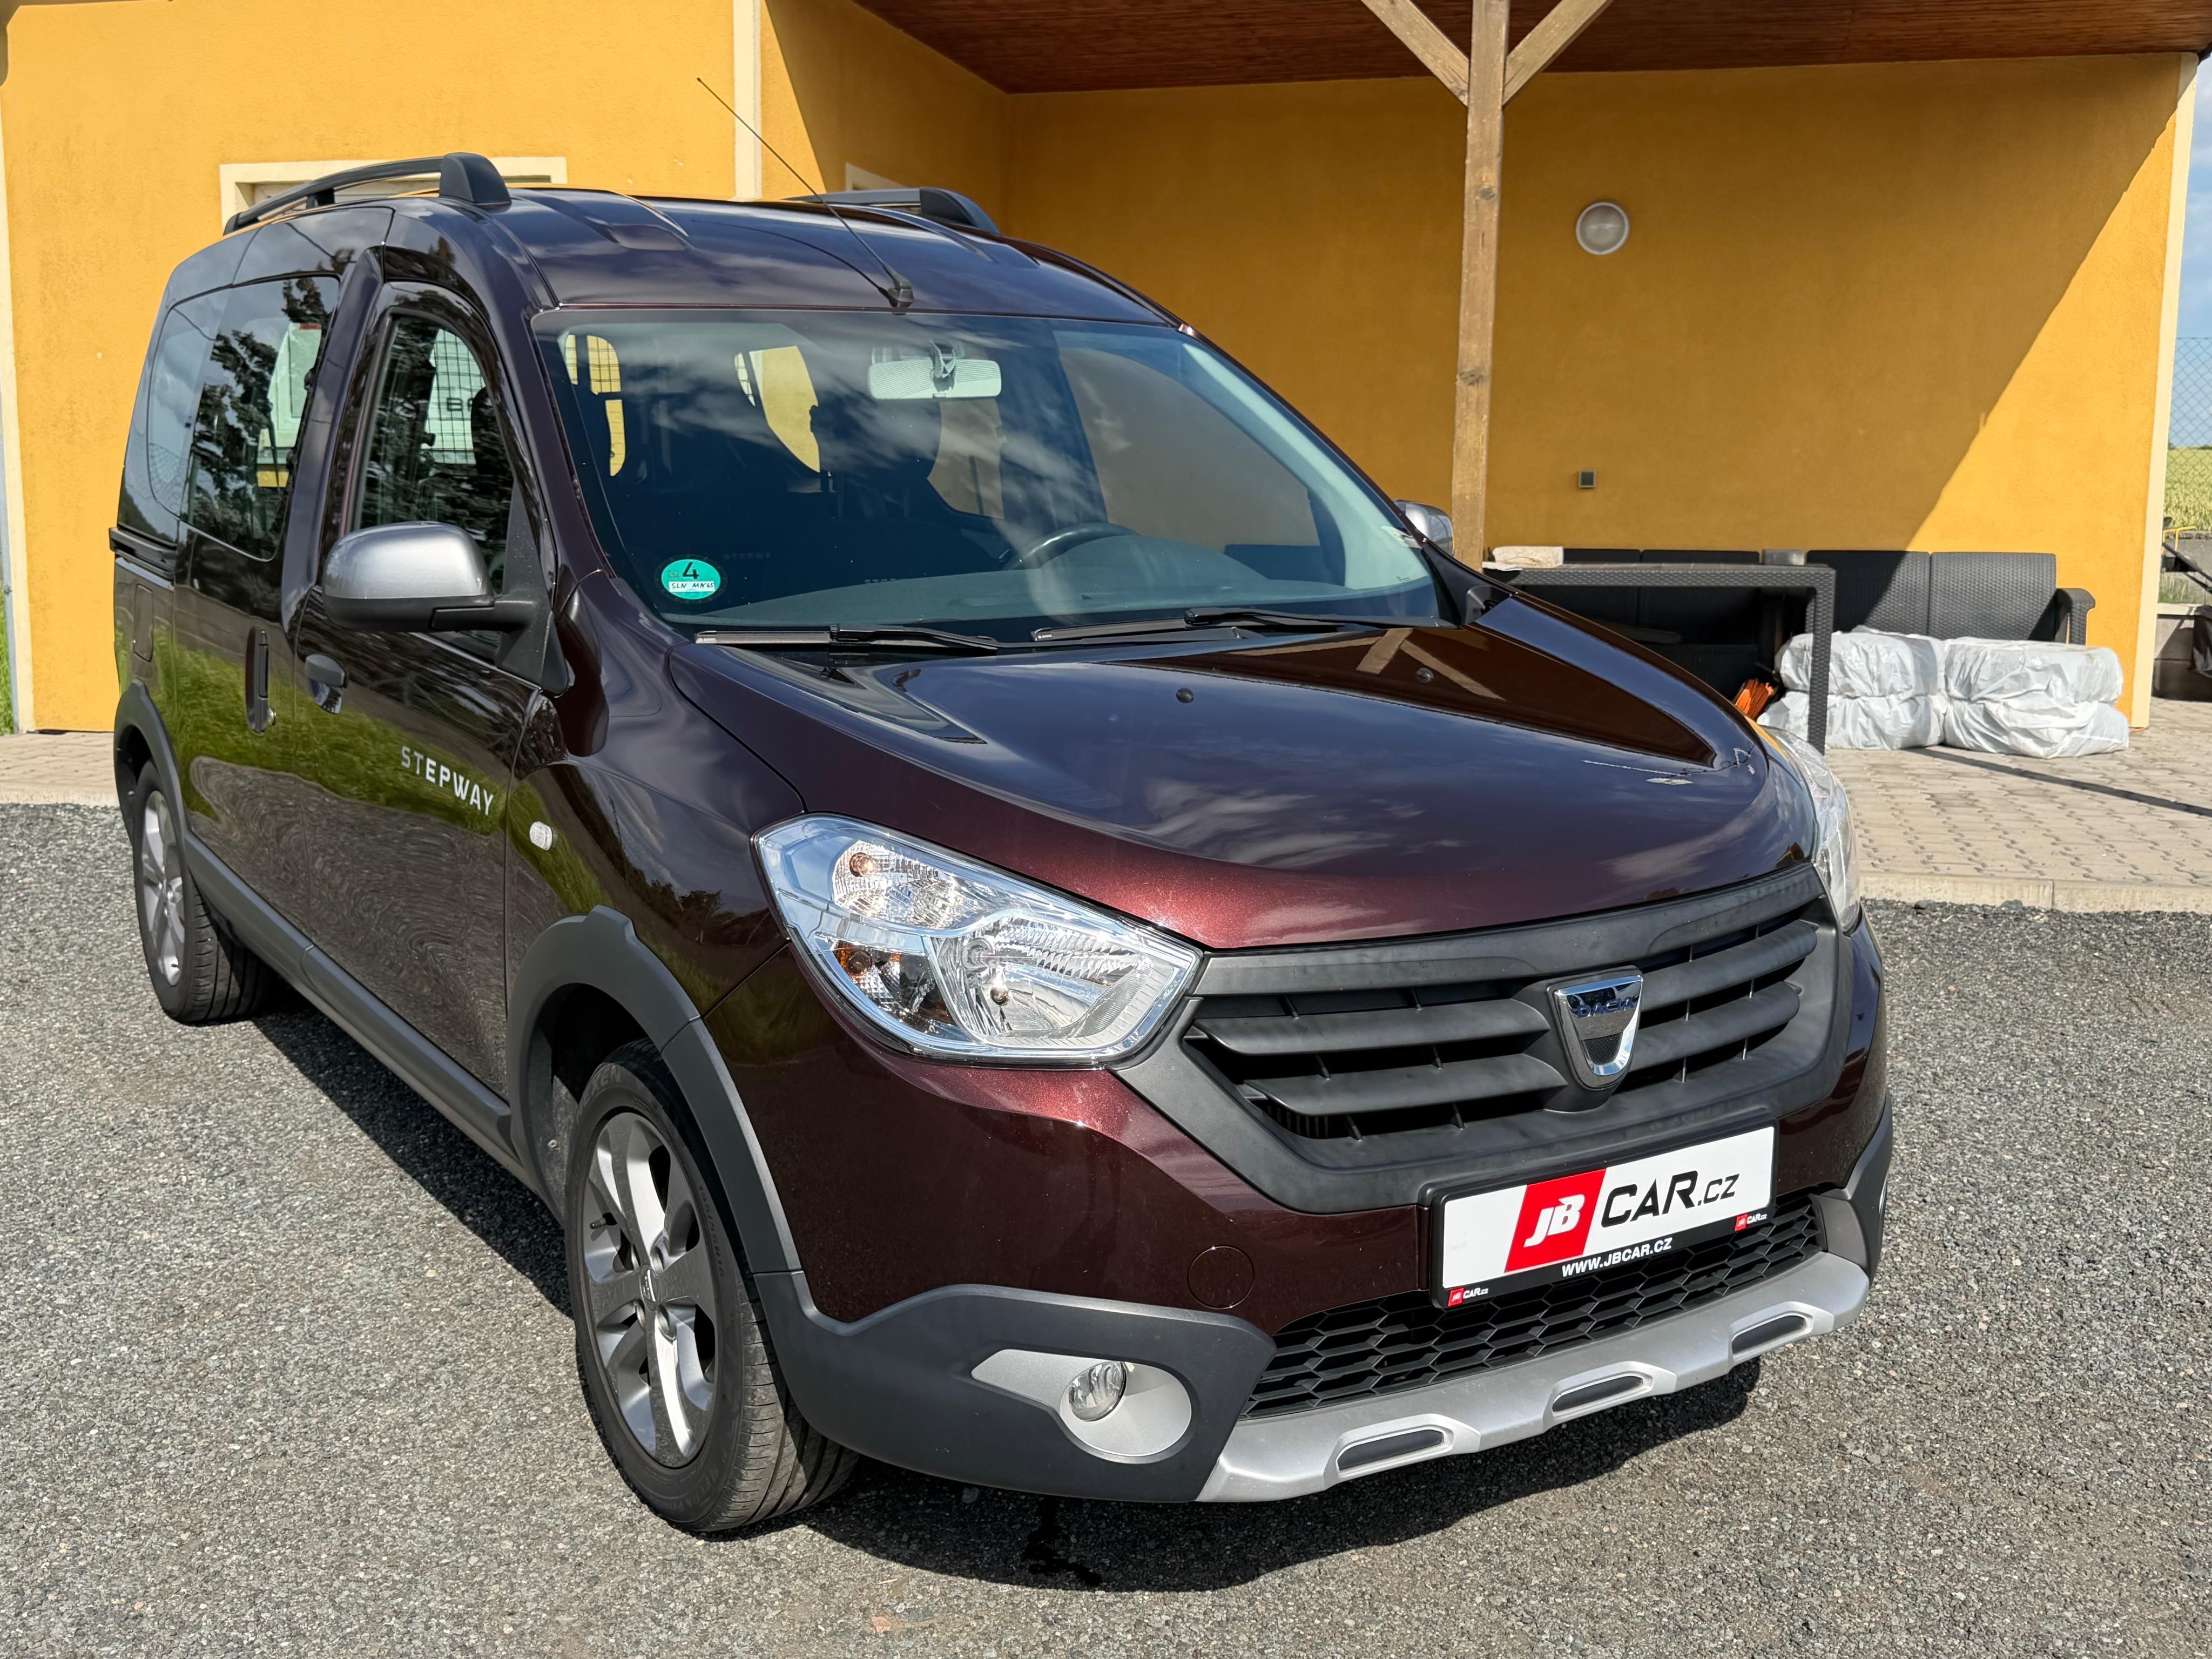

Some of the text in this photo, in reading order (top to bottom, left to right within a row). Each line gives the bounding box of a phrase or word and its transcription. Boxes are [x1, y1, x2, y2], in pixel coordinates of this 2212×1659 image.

[682, 562, 699, 579] 4
[401, 745, 494, 817] STEPWAY
[1576, 996, 1635, 1020] DACIA
[1523, 1194, 1585, 1248] JB
[1561, 1237, 1673, 1277] WWW.JBCAR.CZ
